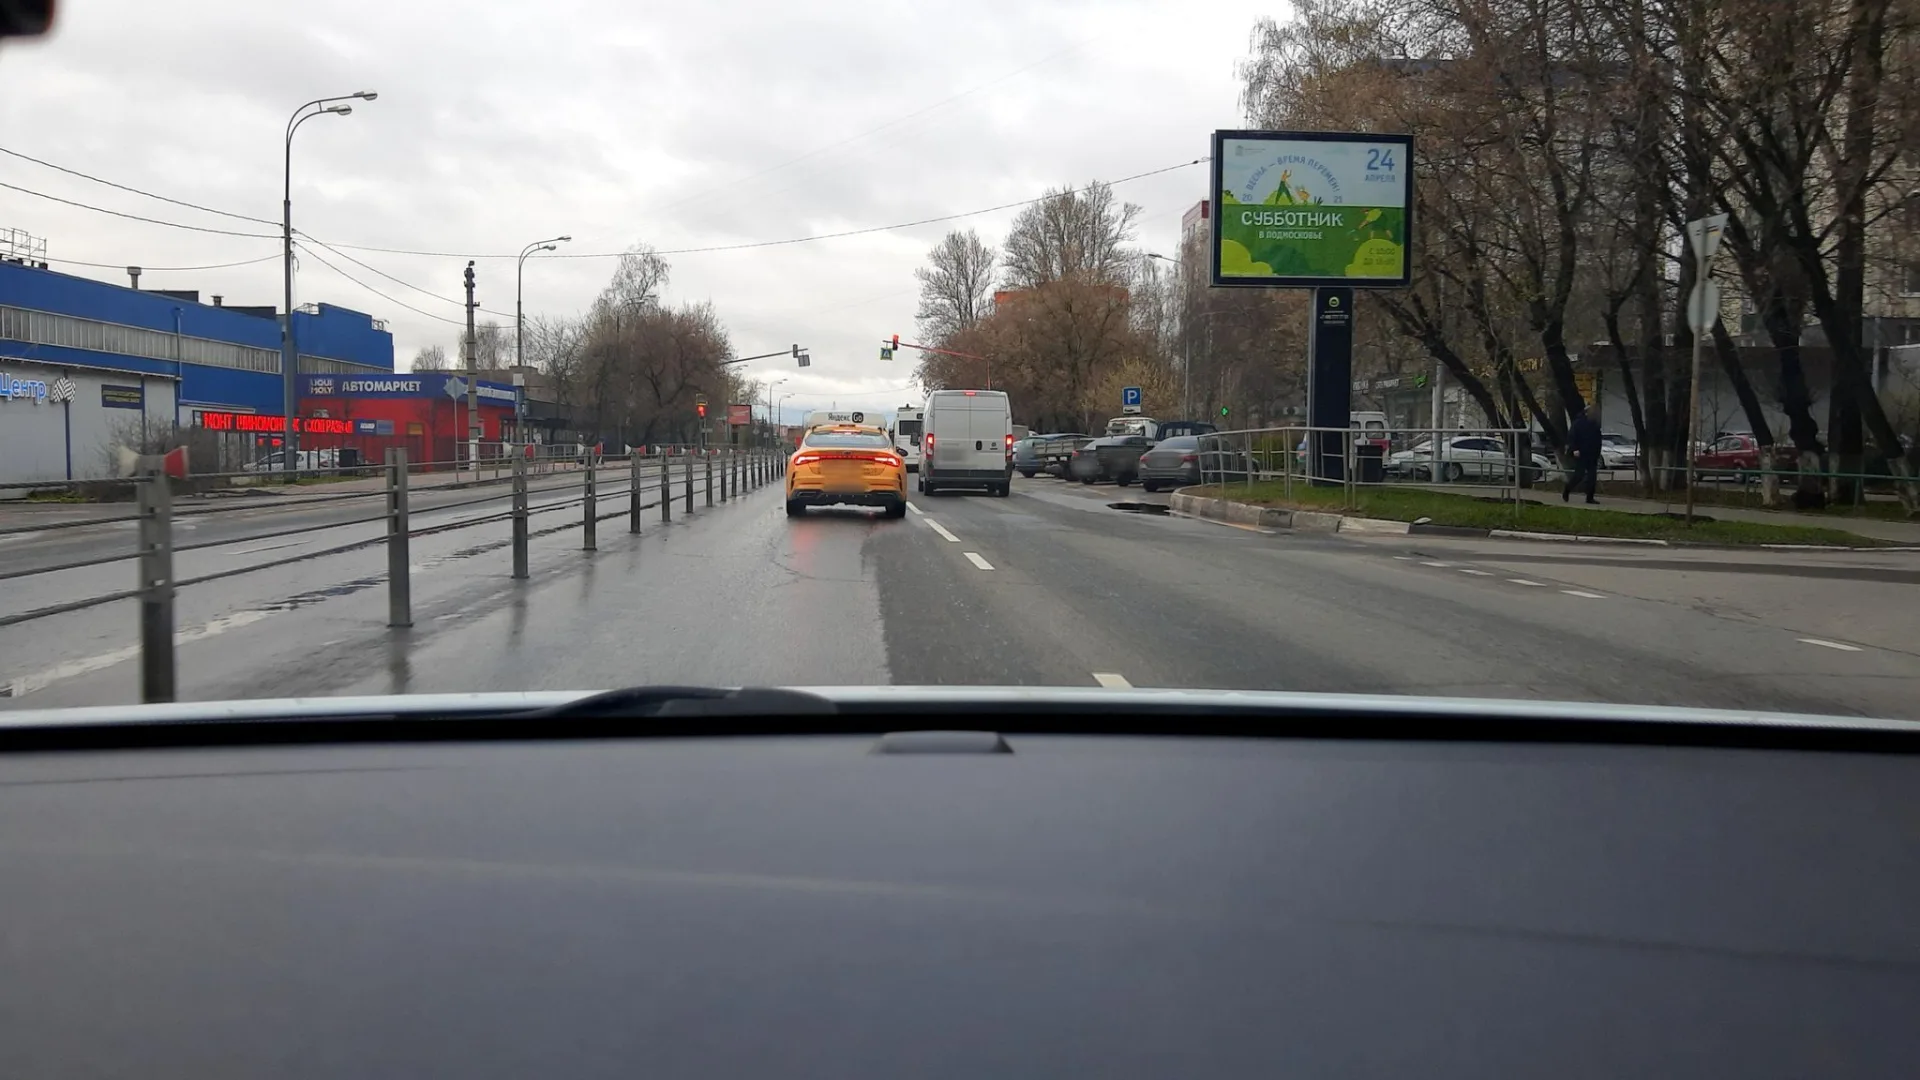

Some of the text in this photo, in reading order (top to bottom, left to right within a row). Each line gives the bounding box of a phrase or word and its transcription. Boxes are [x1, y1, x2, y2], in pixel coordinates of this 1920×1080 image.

[1367, 148, 1395, 171] 24
[1245, 166, 1267, 191] ВЕСНА
[1277, 154, 1306, 166] ВРЕМЯ
[1365, 174, 1395, 183] АПРЕЛЯ
[1242, 210, 1343, 226] СУББОТНИК
[1266, 231, 1323, 240] ПОДМОСКОВЬЕ
[0, 372, 46, 404] Центр
[311, 378, 333, 386] LIQUI
[342, 380, 422, 393] АВТОМАРКЕТ
[311, 386, 334, 394] MOLY
[1127, 390, 1138, 404] P
[828, 412, 863, 421] Яндекс Go
